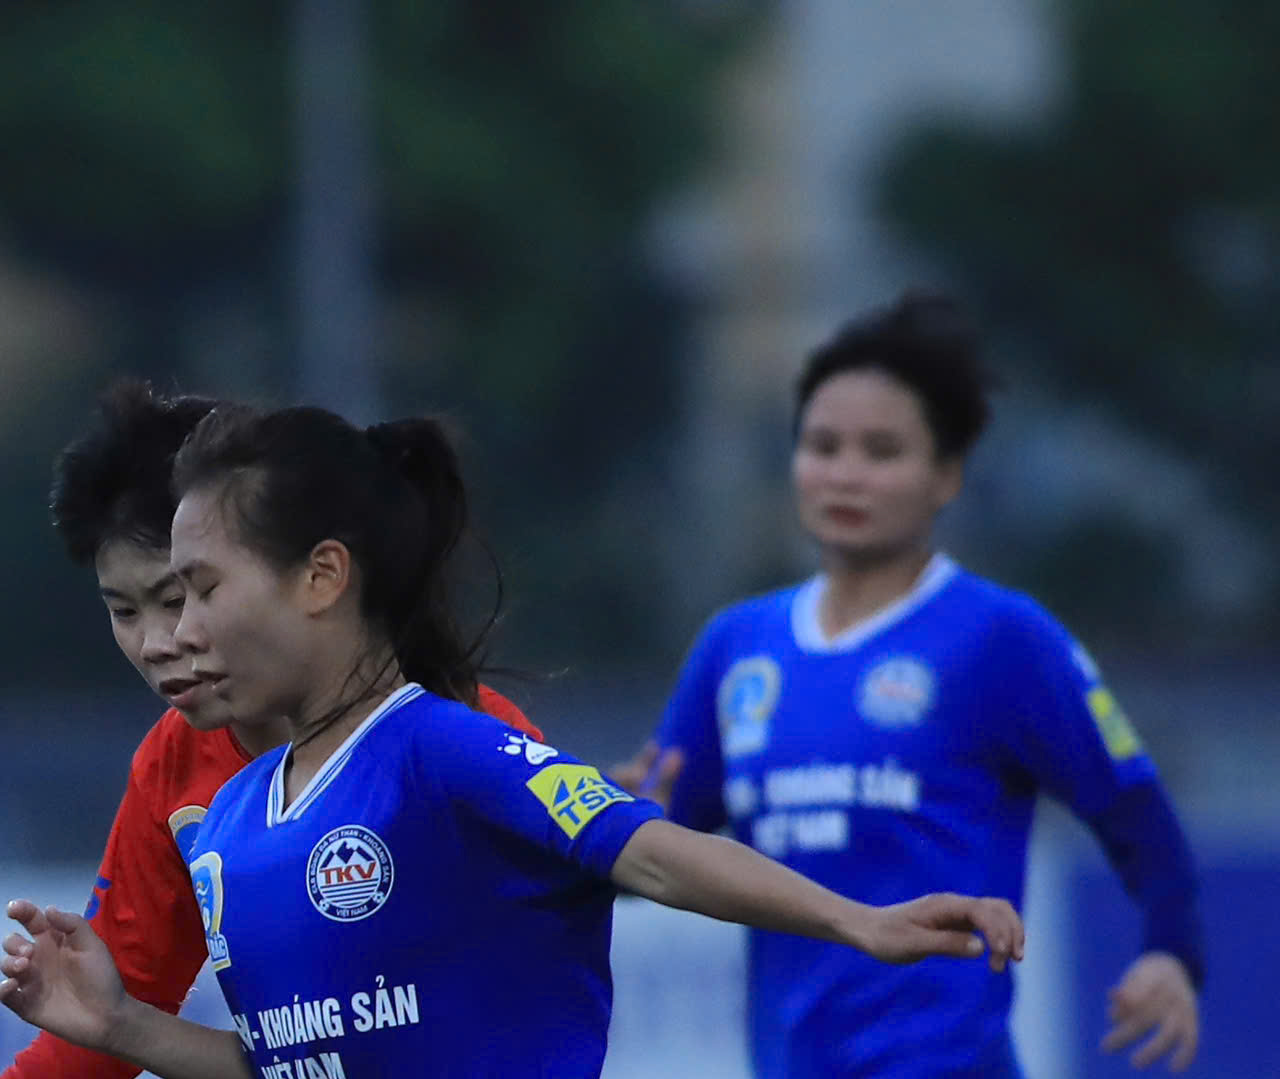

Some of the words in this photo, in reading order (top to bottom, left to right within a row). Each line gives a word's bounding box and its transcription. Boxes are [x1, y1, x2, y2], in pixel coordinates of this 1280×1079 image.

[319, 861, 376, 884] TKV
[258, 994, 345, 1049] KHOÁNG
[351, 975, 419, 1033] SẢN
